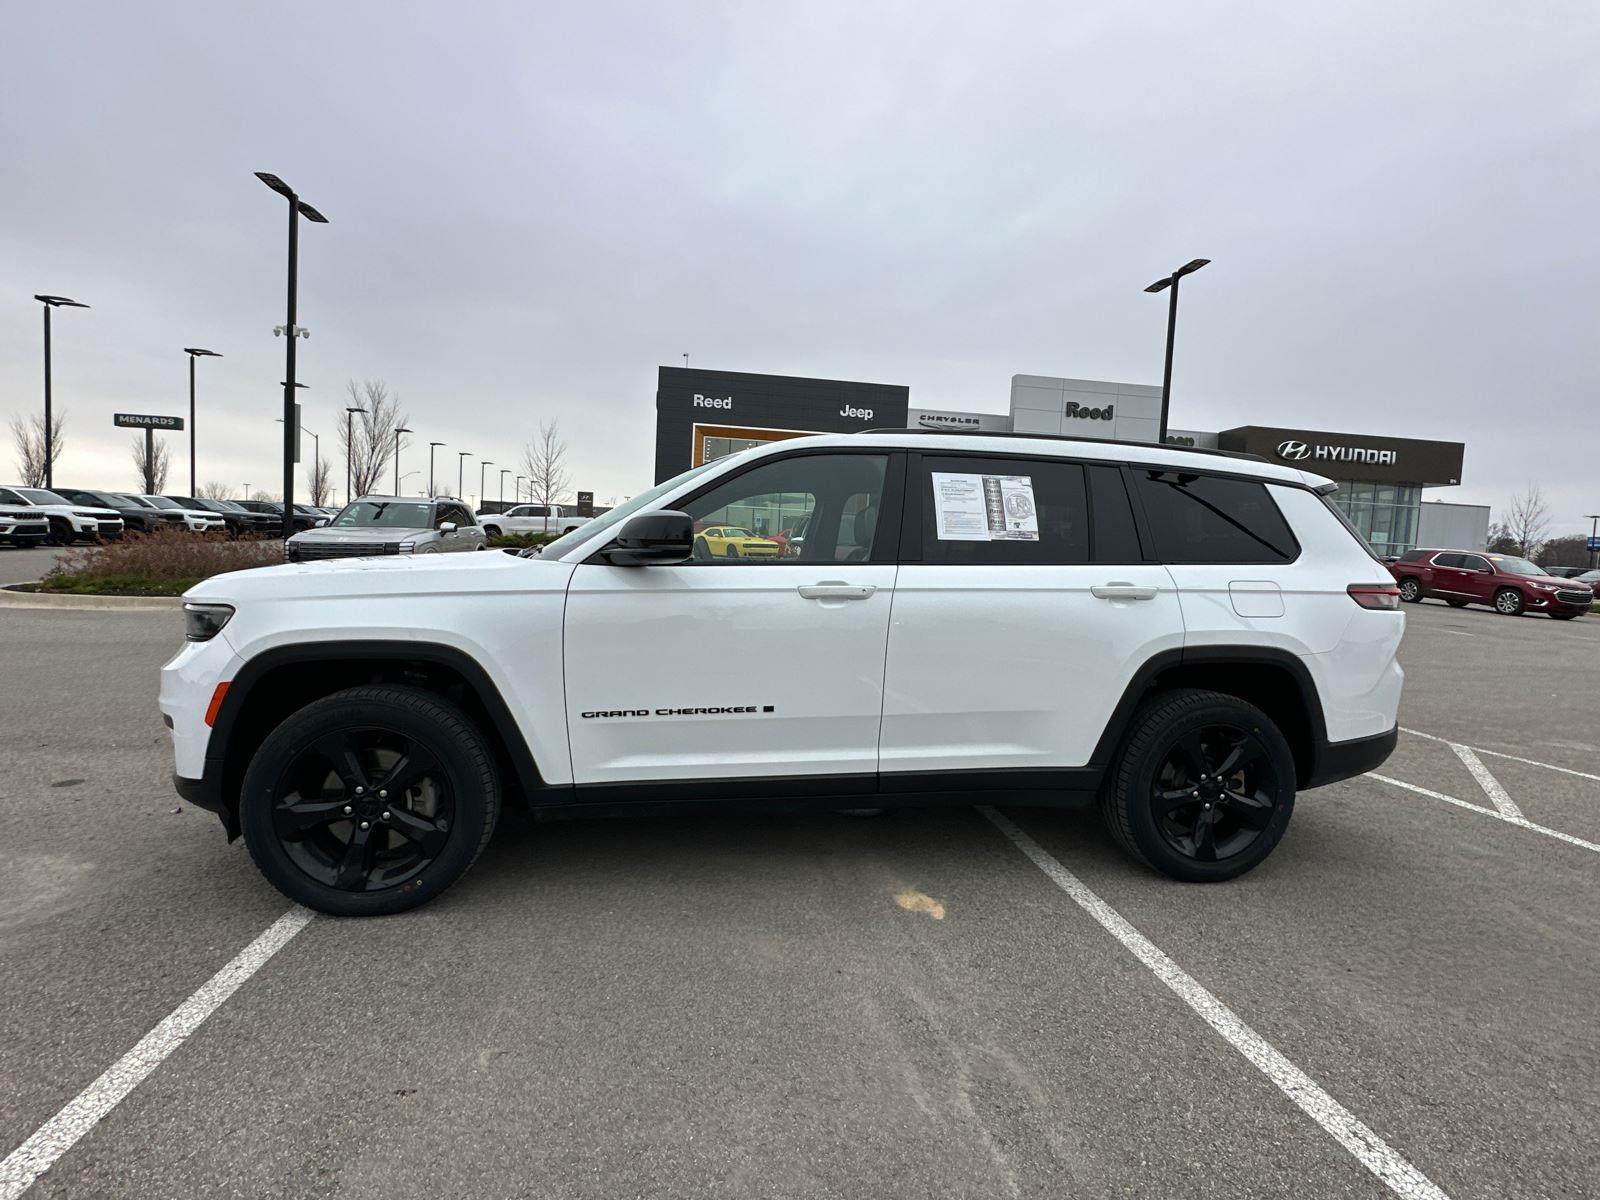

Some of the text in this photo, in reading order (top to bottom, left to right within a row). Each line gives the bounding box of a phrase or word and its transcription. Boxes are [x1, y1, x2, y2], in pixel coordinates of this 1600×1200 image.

[693, 394, 732, 409] Reed
[840, 404, 874, 420] Jeep
[1066, 401, 1114, 421] Reed
[119, 415, 175, 425] MENARDS
[1315, 445, 1397, 465] HYUNDAI
[581, 709, 650, 719] GRAND
[655, 705, 758, 716] CHEROKEE
